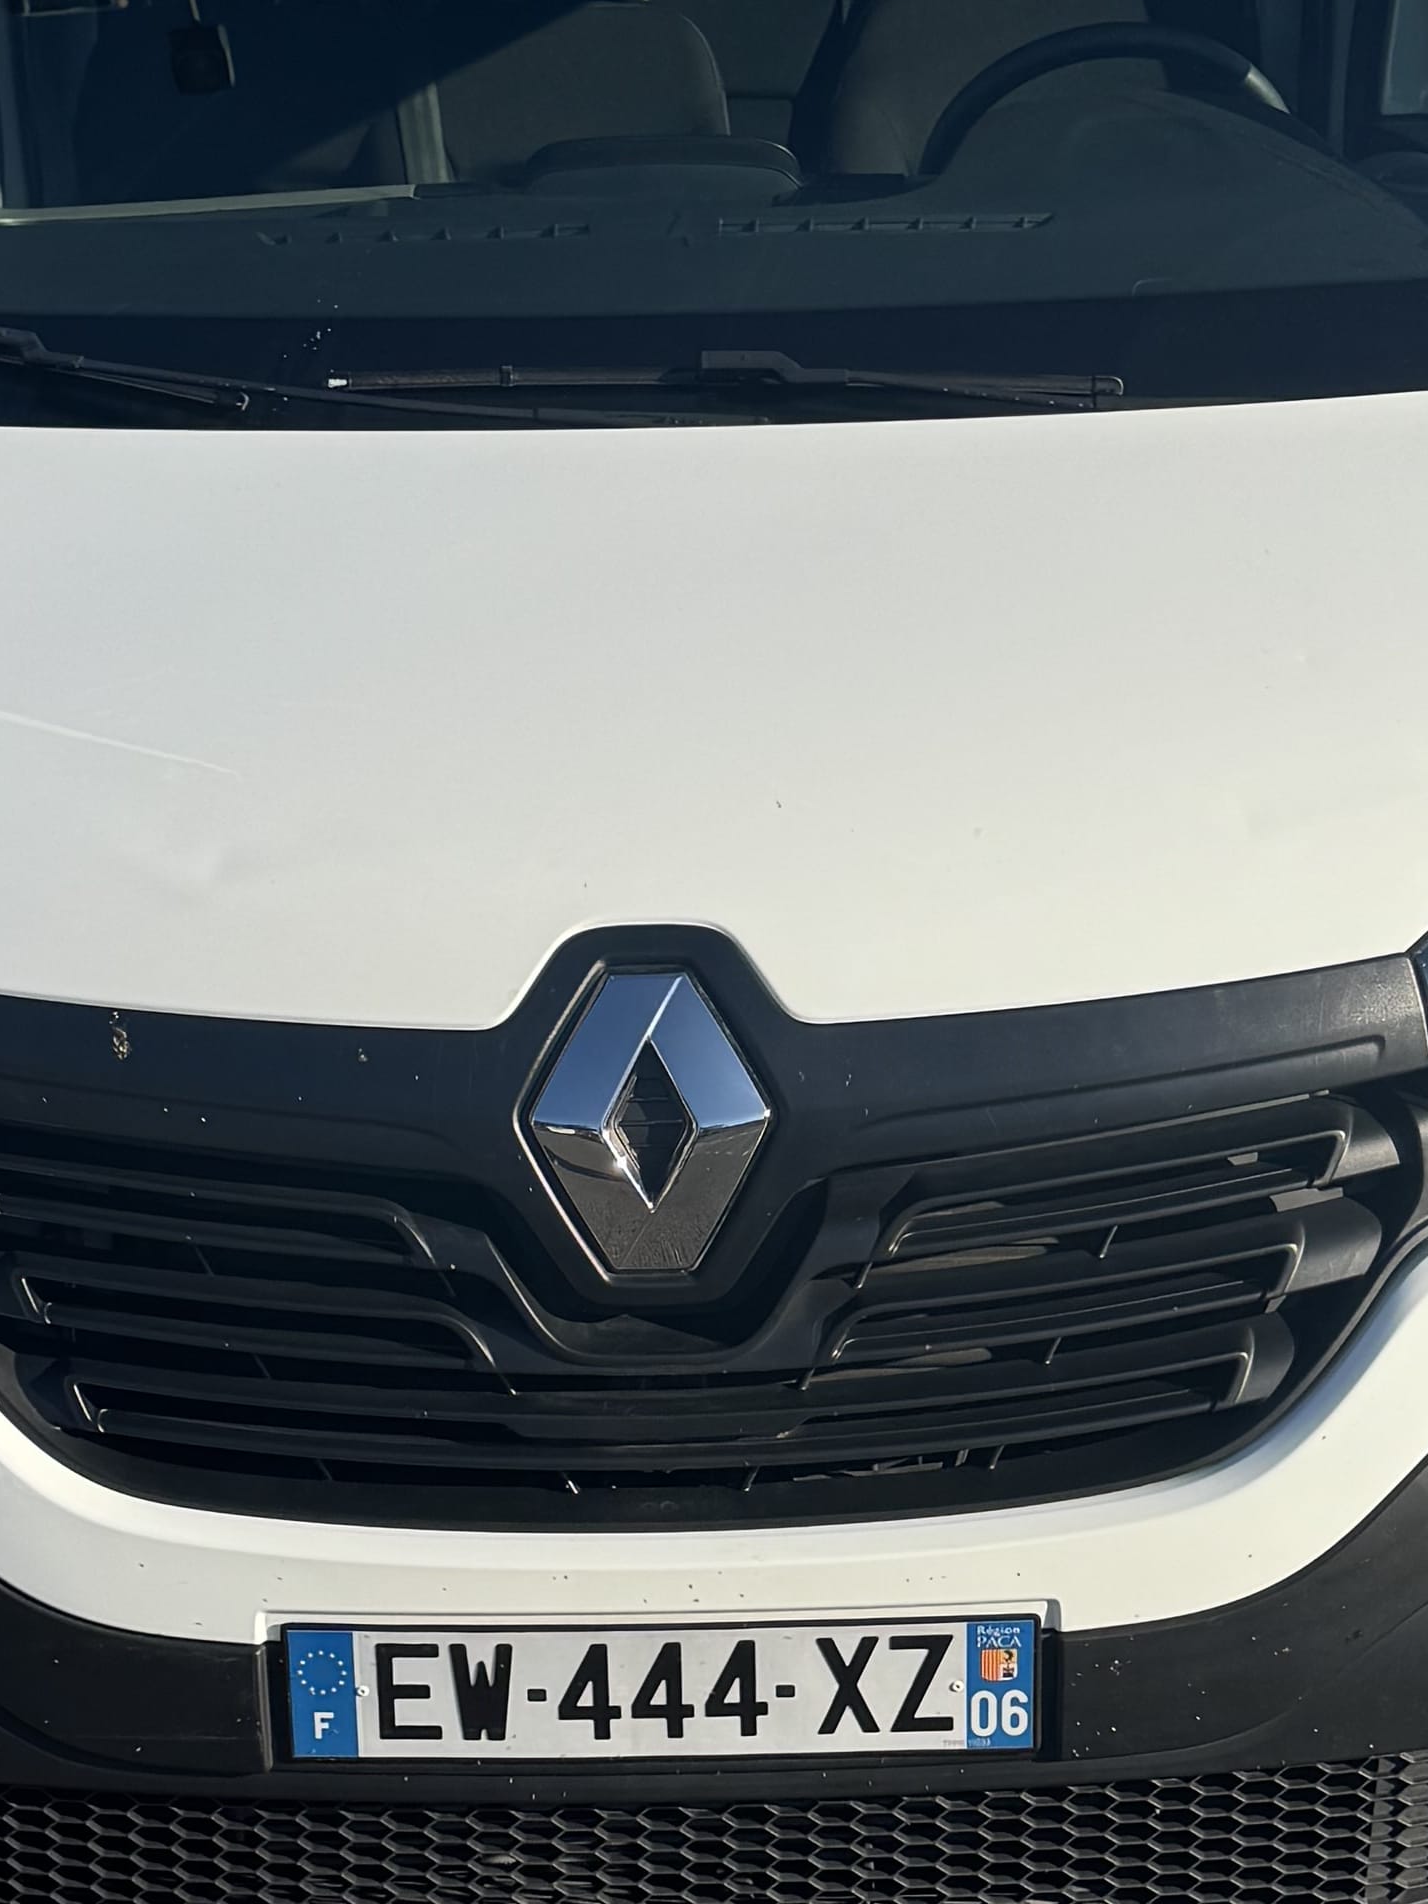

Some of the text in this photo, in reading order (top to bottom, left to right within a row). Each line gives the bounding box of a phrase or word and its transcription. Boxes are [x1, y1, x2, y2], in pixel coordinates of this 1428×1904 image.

[976, 1635, 1022, 1649] PACA
[977, 1625, 1021, 1637] Région
[314, 1634, 954, 1741] F EW-444-XZ
[970, 1689, 1029, 1737] 06
